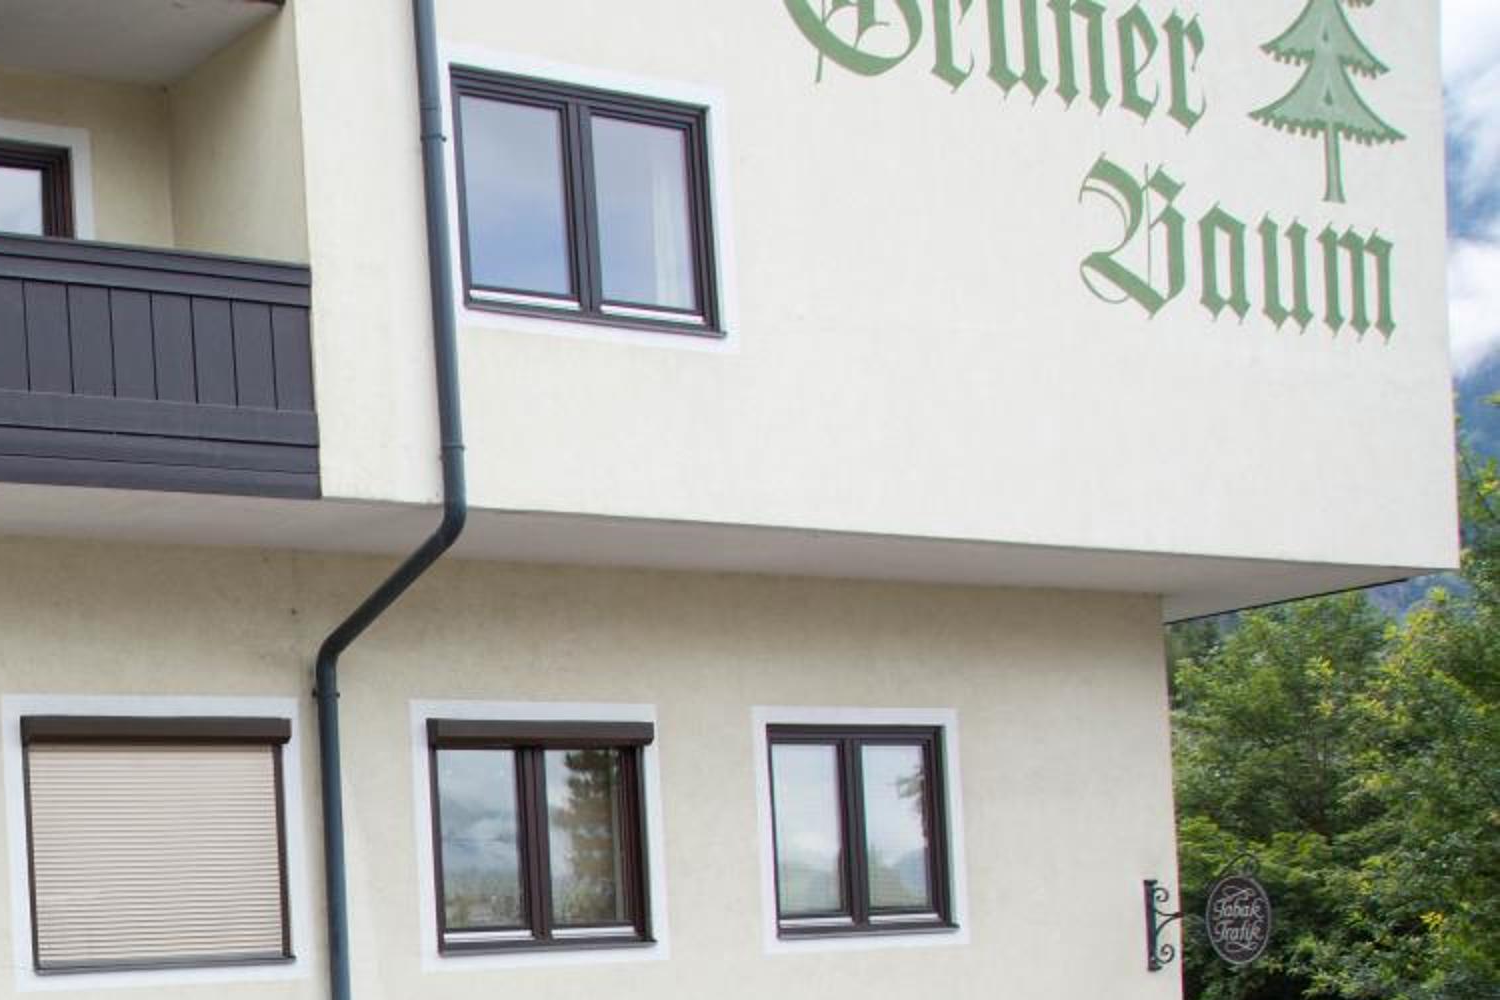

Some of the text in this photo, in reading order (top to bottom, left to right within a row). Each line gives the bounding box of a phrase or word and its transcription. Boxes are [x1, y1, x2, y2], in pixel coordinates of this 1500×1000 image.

[1079, 151, 1397, 344] Baum
[1211, 892, 1268, 920] Tabak
[1211, 919, 1265, 945] Trafik
